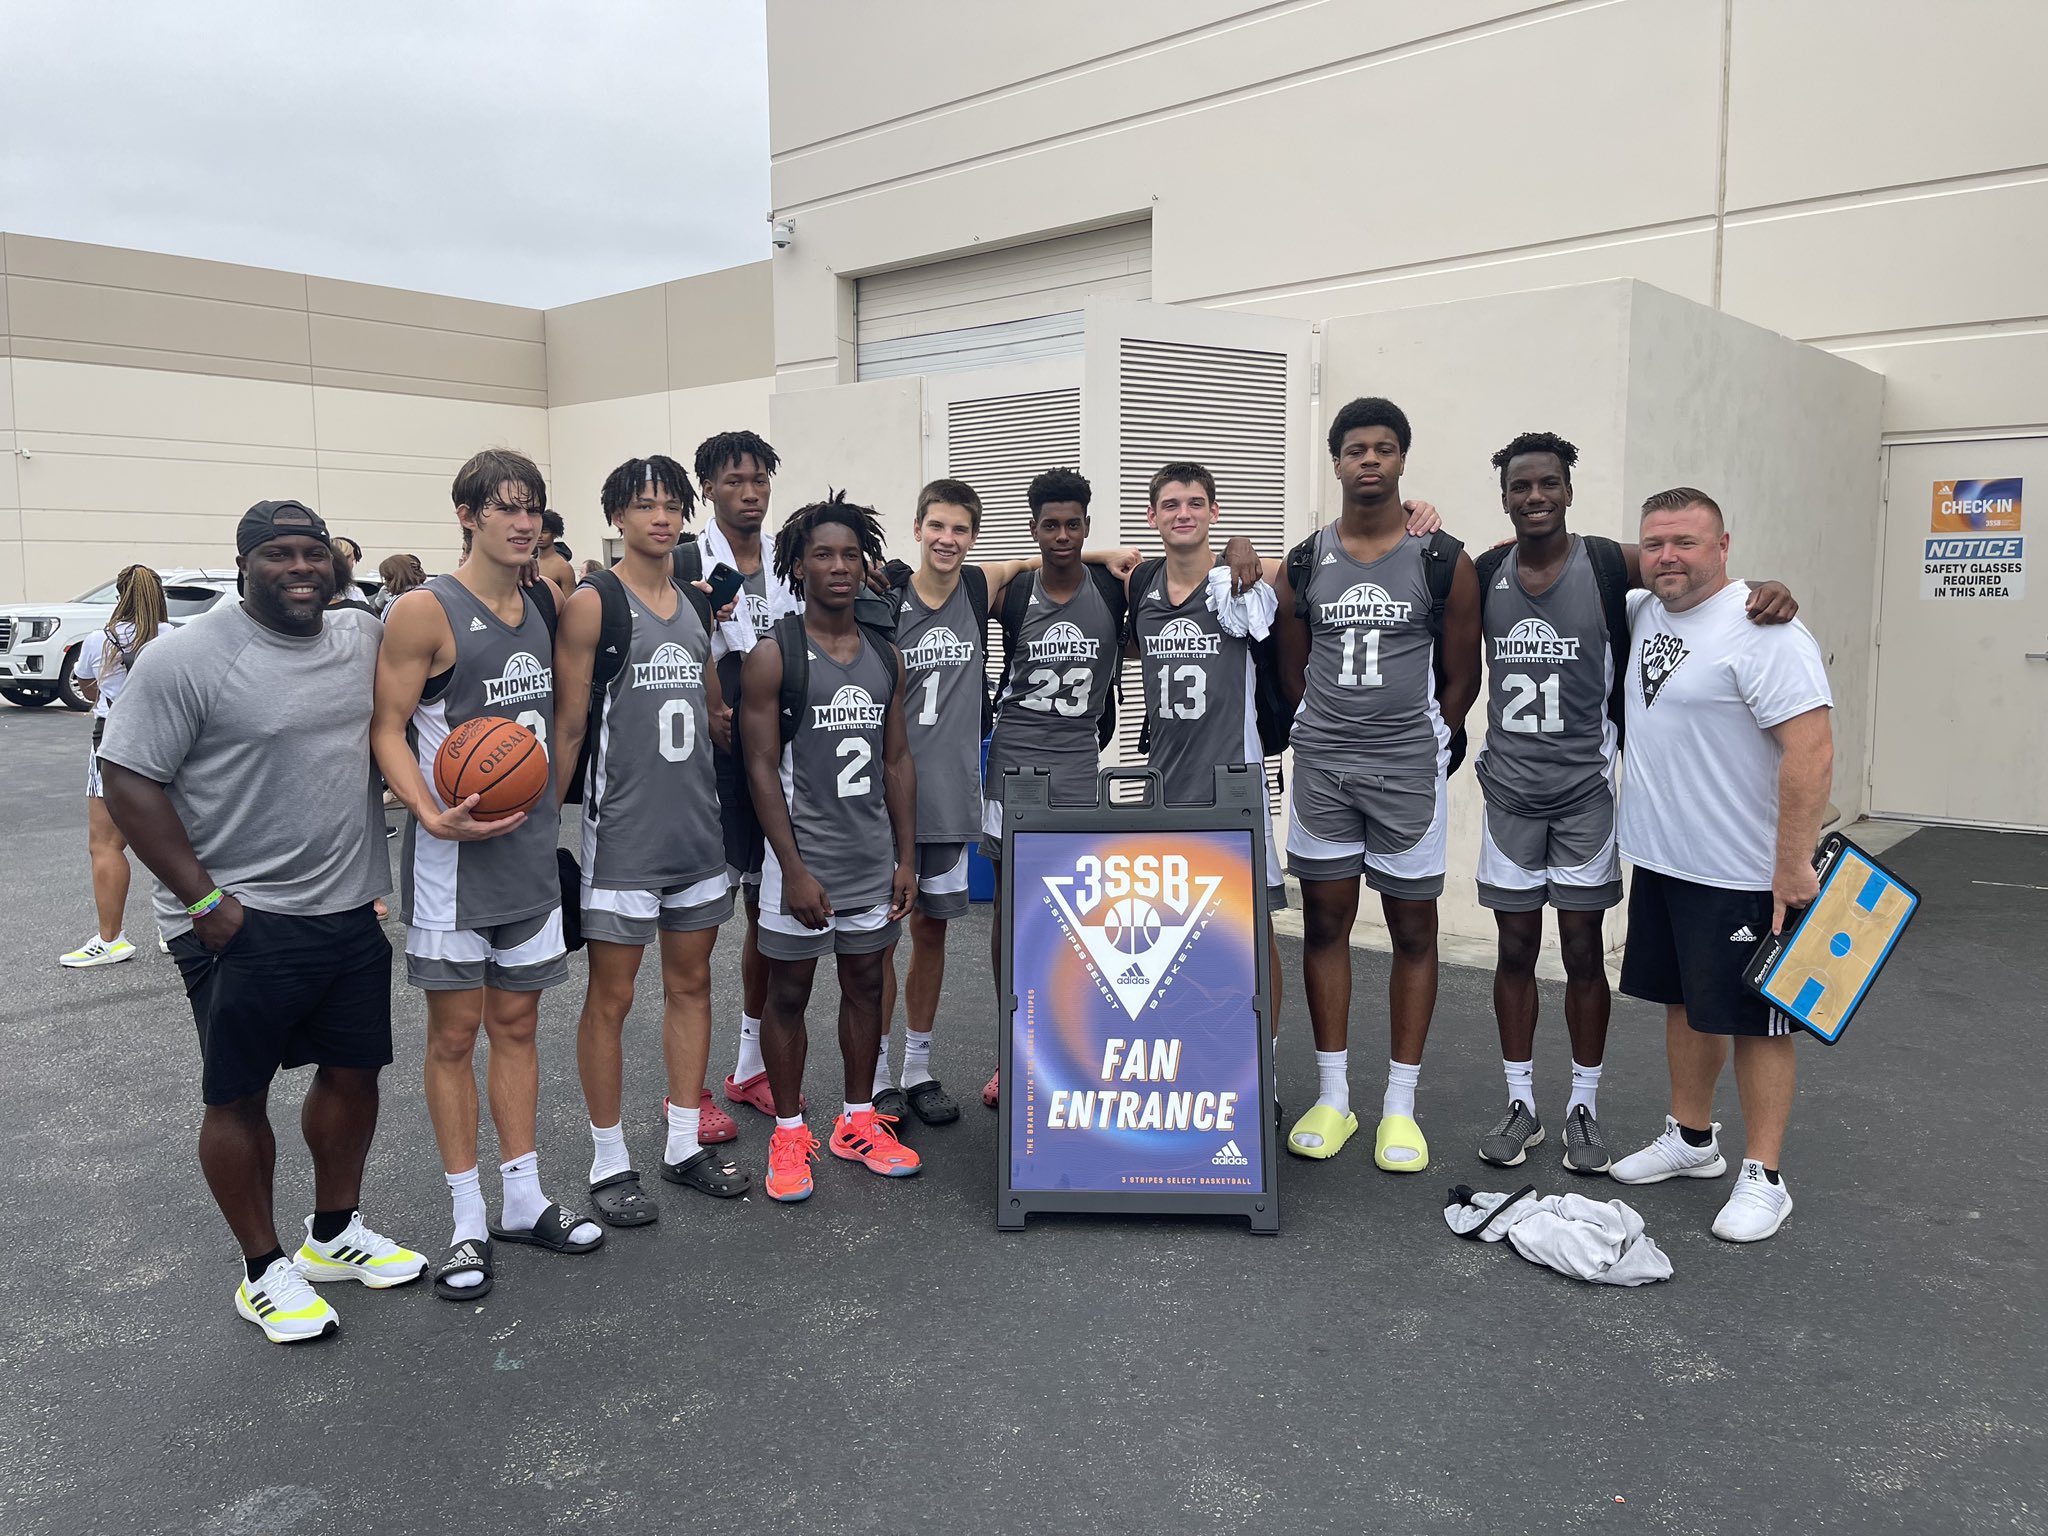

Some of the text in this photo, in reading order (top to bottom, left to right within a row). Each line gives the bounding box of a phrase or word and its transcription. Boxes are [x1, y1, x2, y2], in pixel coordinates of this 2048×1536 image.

[1941, 499, 2013, 515] CHECK IN
[1928, 540, 2019, 558] NOTICE
[1924, 562, 2022, 574] SAFETY GLASSES
[1943, 575, 2001, 586] REQUIRED
[1934, 587, 2009, 597] IN THIS AREA
[1324, 603, 1409, 621] MIDWEST
[1032, 641, 1097, 658] MIDWEST
[1149, 636, 1219, 652] MIDWEST
[1498, 640, 1577, 657] MIDWEST
[1645, 632, 1684, 667] 3SSB
[906, 644, 971, 667] MIDWEST
[1337, 628, 1383, 686] 11
[1505, 656, 1564, 665] BASKETBALL CLUB
[489, 672, 553, 700] MIDWEST
[646, 683, 684, 691] BASKETBALL
[1019, 667, 1094, 717] 23
[1157, 664, 1207, 720] 13
[500, 694, 537, 707] BASKETBALL
[918, 671, 941, 726] 1
[1501, 673, 1565, 733] 21
[818, 706, 884, 725] MIDWEST
[658, 698, 696, 763] 0
[828, 723, 864, 731] BASKETBALL
[479, 729, 528, 774] OHSAA
[836, 737, 872, 799] 2
[1076, 855, 1189, 916] 3SSB
[1043, 895, 1119, 1010] 3-STRIPES SELECT
[1149, 898, 1222, 1010] BASKETBALL
[1116, 976, 1150, 985] adidas
[1027, 989, 1035, 1025] STRIPES
[1101, 1038, 1181, 1082] FAN
[1026, 1105, 1034, 1135] BRAND
[1047, 1090, 1238, 1132] ENTRANCE
[1026, 1138, 1034, 1155] THE
[1211, 1155, 1248, 1166] adidas
[1129, 1176, 1164, 1184] STRIPES
[1200, 1177, 1252, 1185] BASKETBALL
[441, 1256, 485, 1271] adidas
